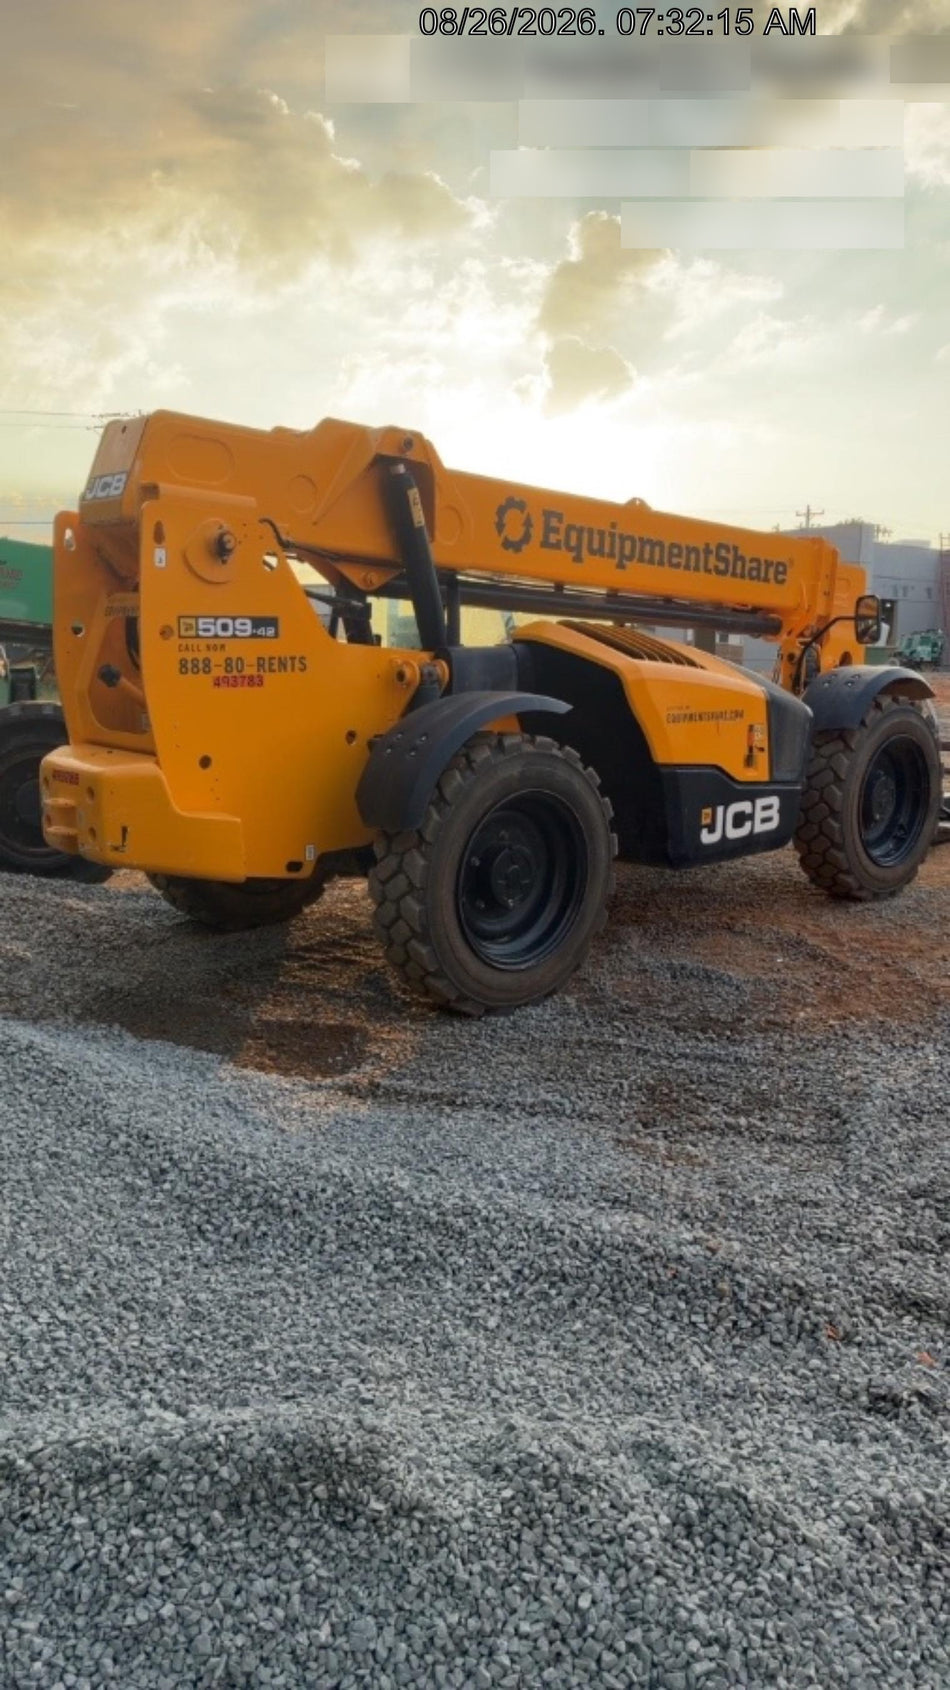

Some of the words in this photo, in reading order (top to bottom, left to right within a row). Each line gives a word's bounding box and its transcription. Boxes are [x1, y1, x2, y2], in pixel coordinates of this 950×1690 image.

[85, 472, 127, 499] JCB
[540, 508, 788, 585] EquipmentShare
[178, 643, 201, 652] CALL
[179, 656, 307, 675] 888-80-RENTS
[213, 675, 264, 688] 493783
[700, 796, 780, 844] JCB
